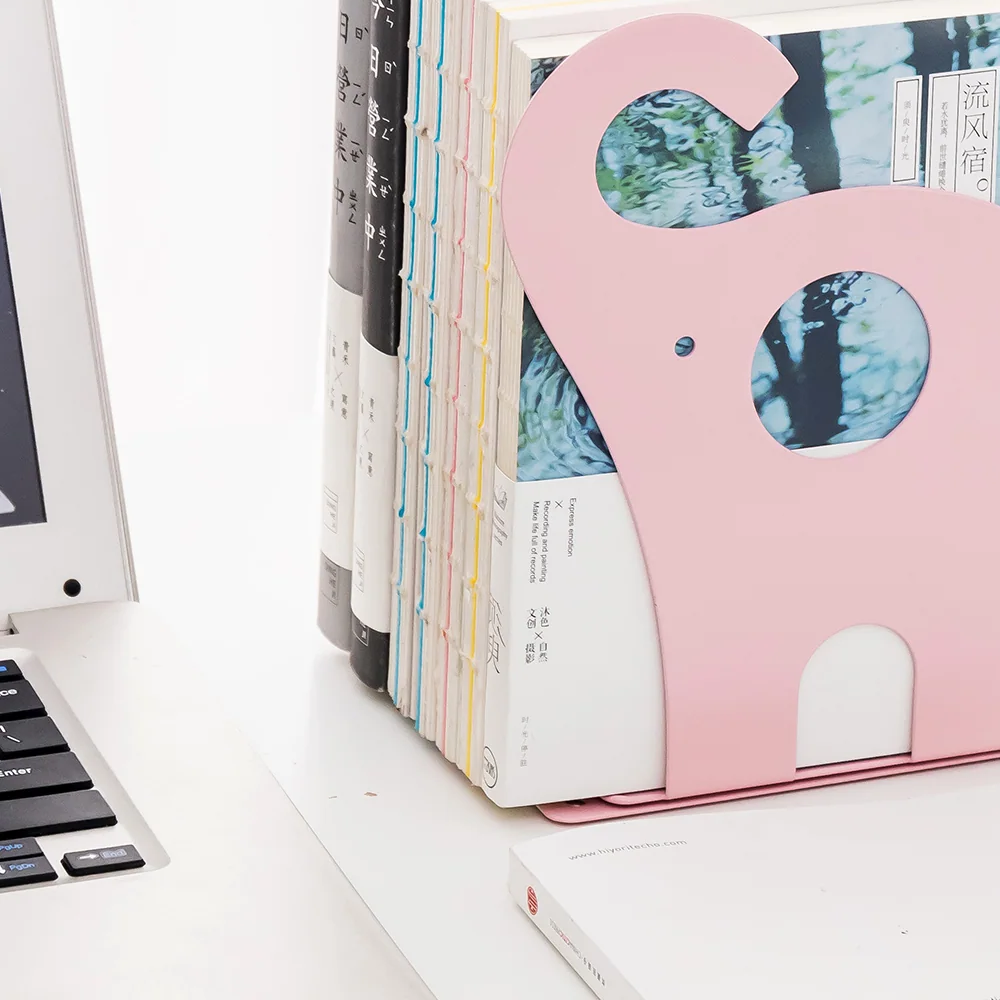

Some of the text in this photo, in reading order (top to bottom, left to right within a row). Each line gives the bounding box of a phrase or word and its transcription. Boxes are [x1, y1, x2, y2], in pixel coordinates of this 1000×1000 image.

[532, 501, 540, 521] Make
[541, 500, 551, 537] Recording
[567, 497, 577, 558] Express emotion
[531, 535, 539, 547] full
[539, 554, 548, 583] painting
[0, 767, 32, 778] Enter
[102, 849, 125, 859] End
[568, 839, 688, 861] www.hiyoritecho.com
[9, 862, 36, 871] PgDn
